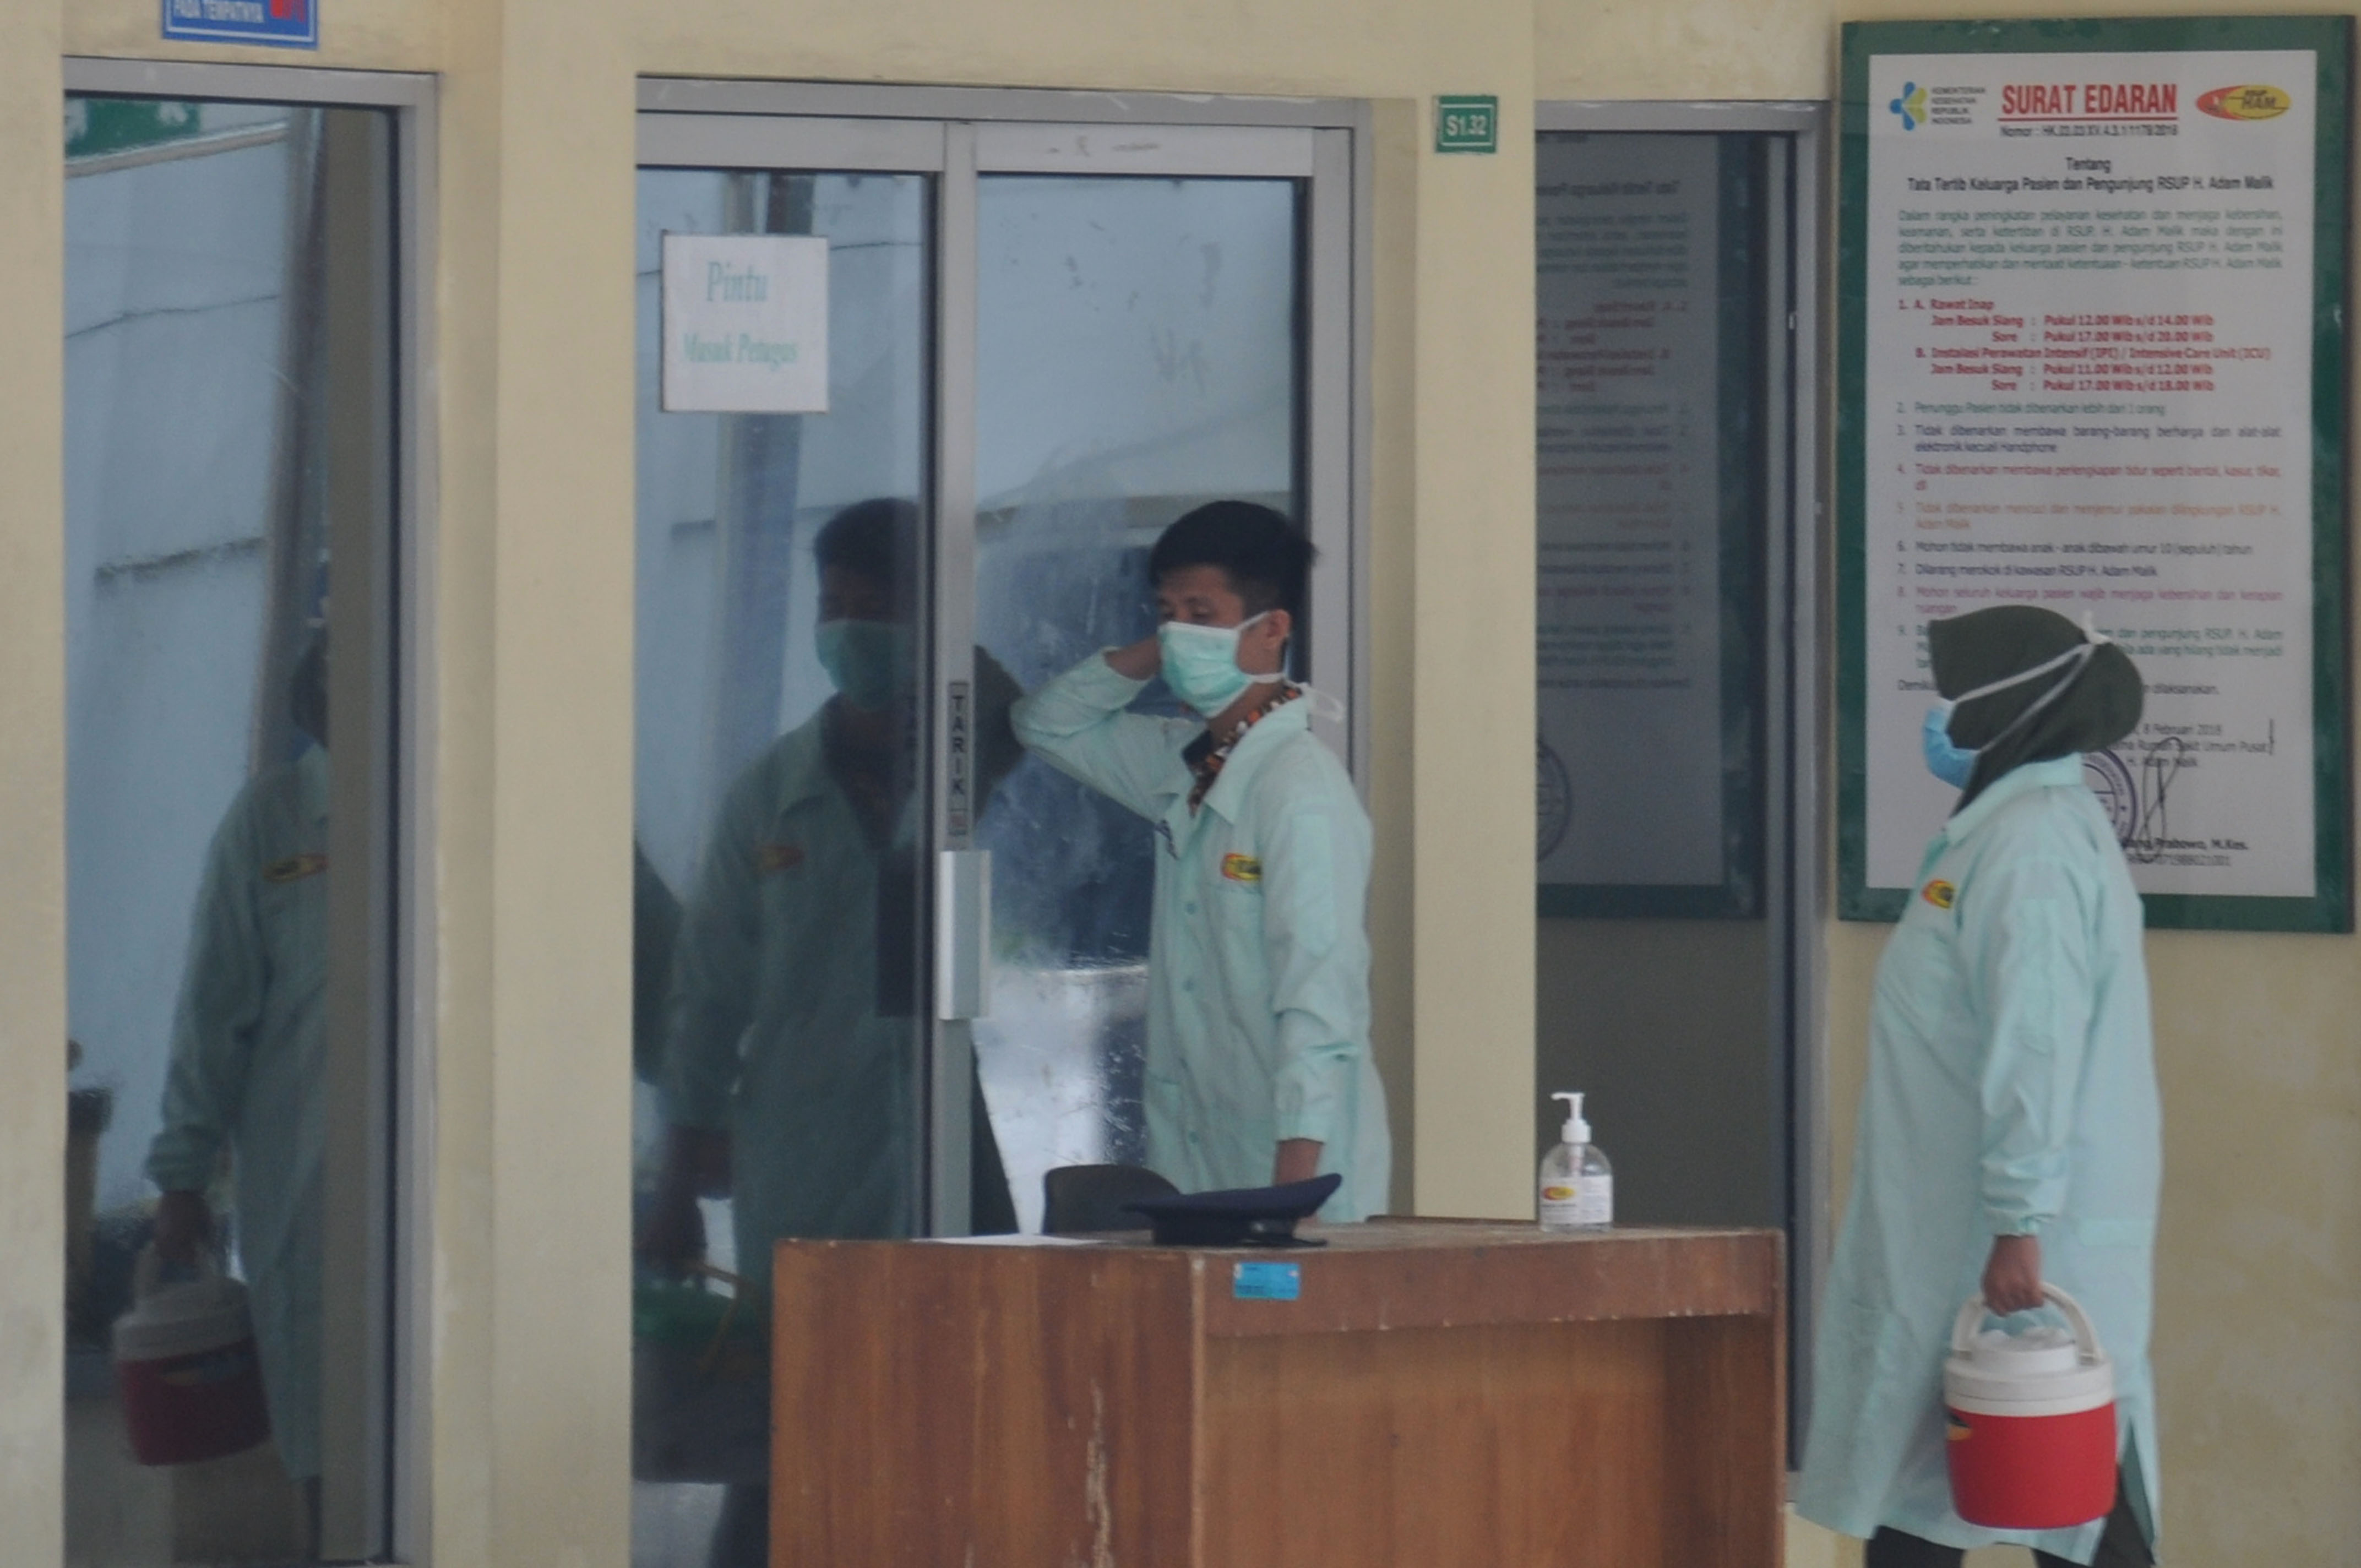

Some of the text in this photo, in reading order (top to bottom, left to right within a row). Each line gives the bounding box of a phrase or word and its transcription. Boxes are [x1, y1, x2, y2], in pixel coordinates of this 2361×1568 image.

[2002, 84, 2177, 114] SURAT EDARAN
[2065, 156, 2111, 174] Tentang
[1907, 177, 1931, 190] Tata
[1934, 177, 1966, 190] Tertib
[1969, 177, 2019, 193] Keluarga
[2022, 176, 2059, 190] Pasien
[2062, 177, 2083, 190] dan
[2086, 176, 2153, 193] Pengunjung
[2157, 176, 2190, 189] RSUP
[2208, 176, 2241, 189] Adam
[2244, 175, 2274, 189] Malik
[706, 261, 767, 301] Pintu
[952, 695, 965, 795] TARIK
